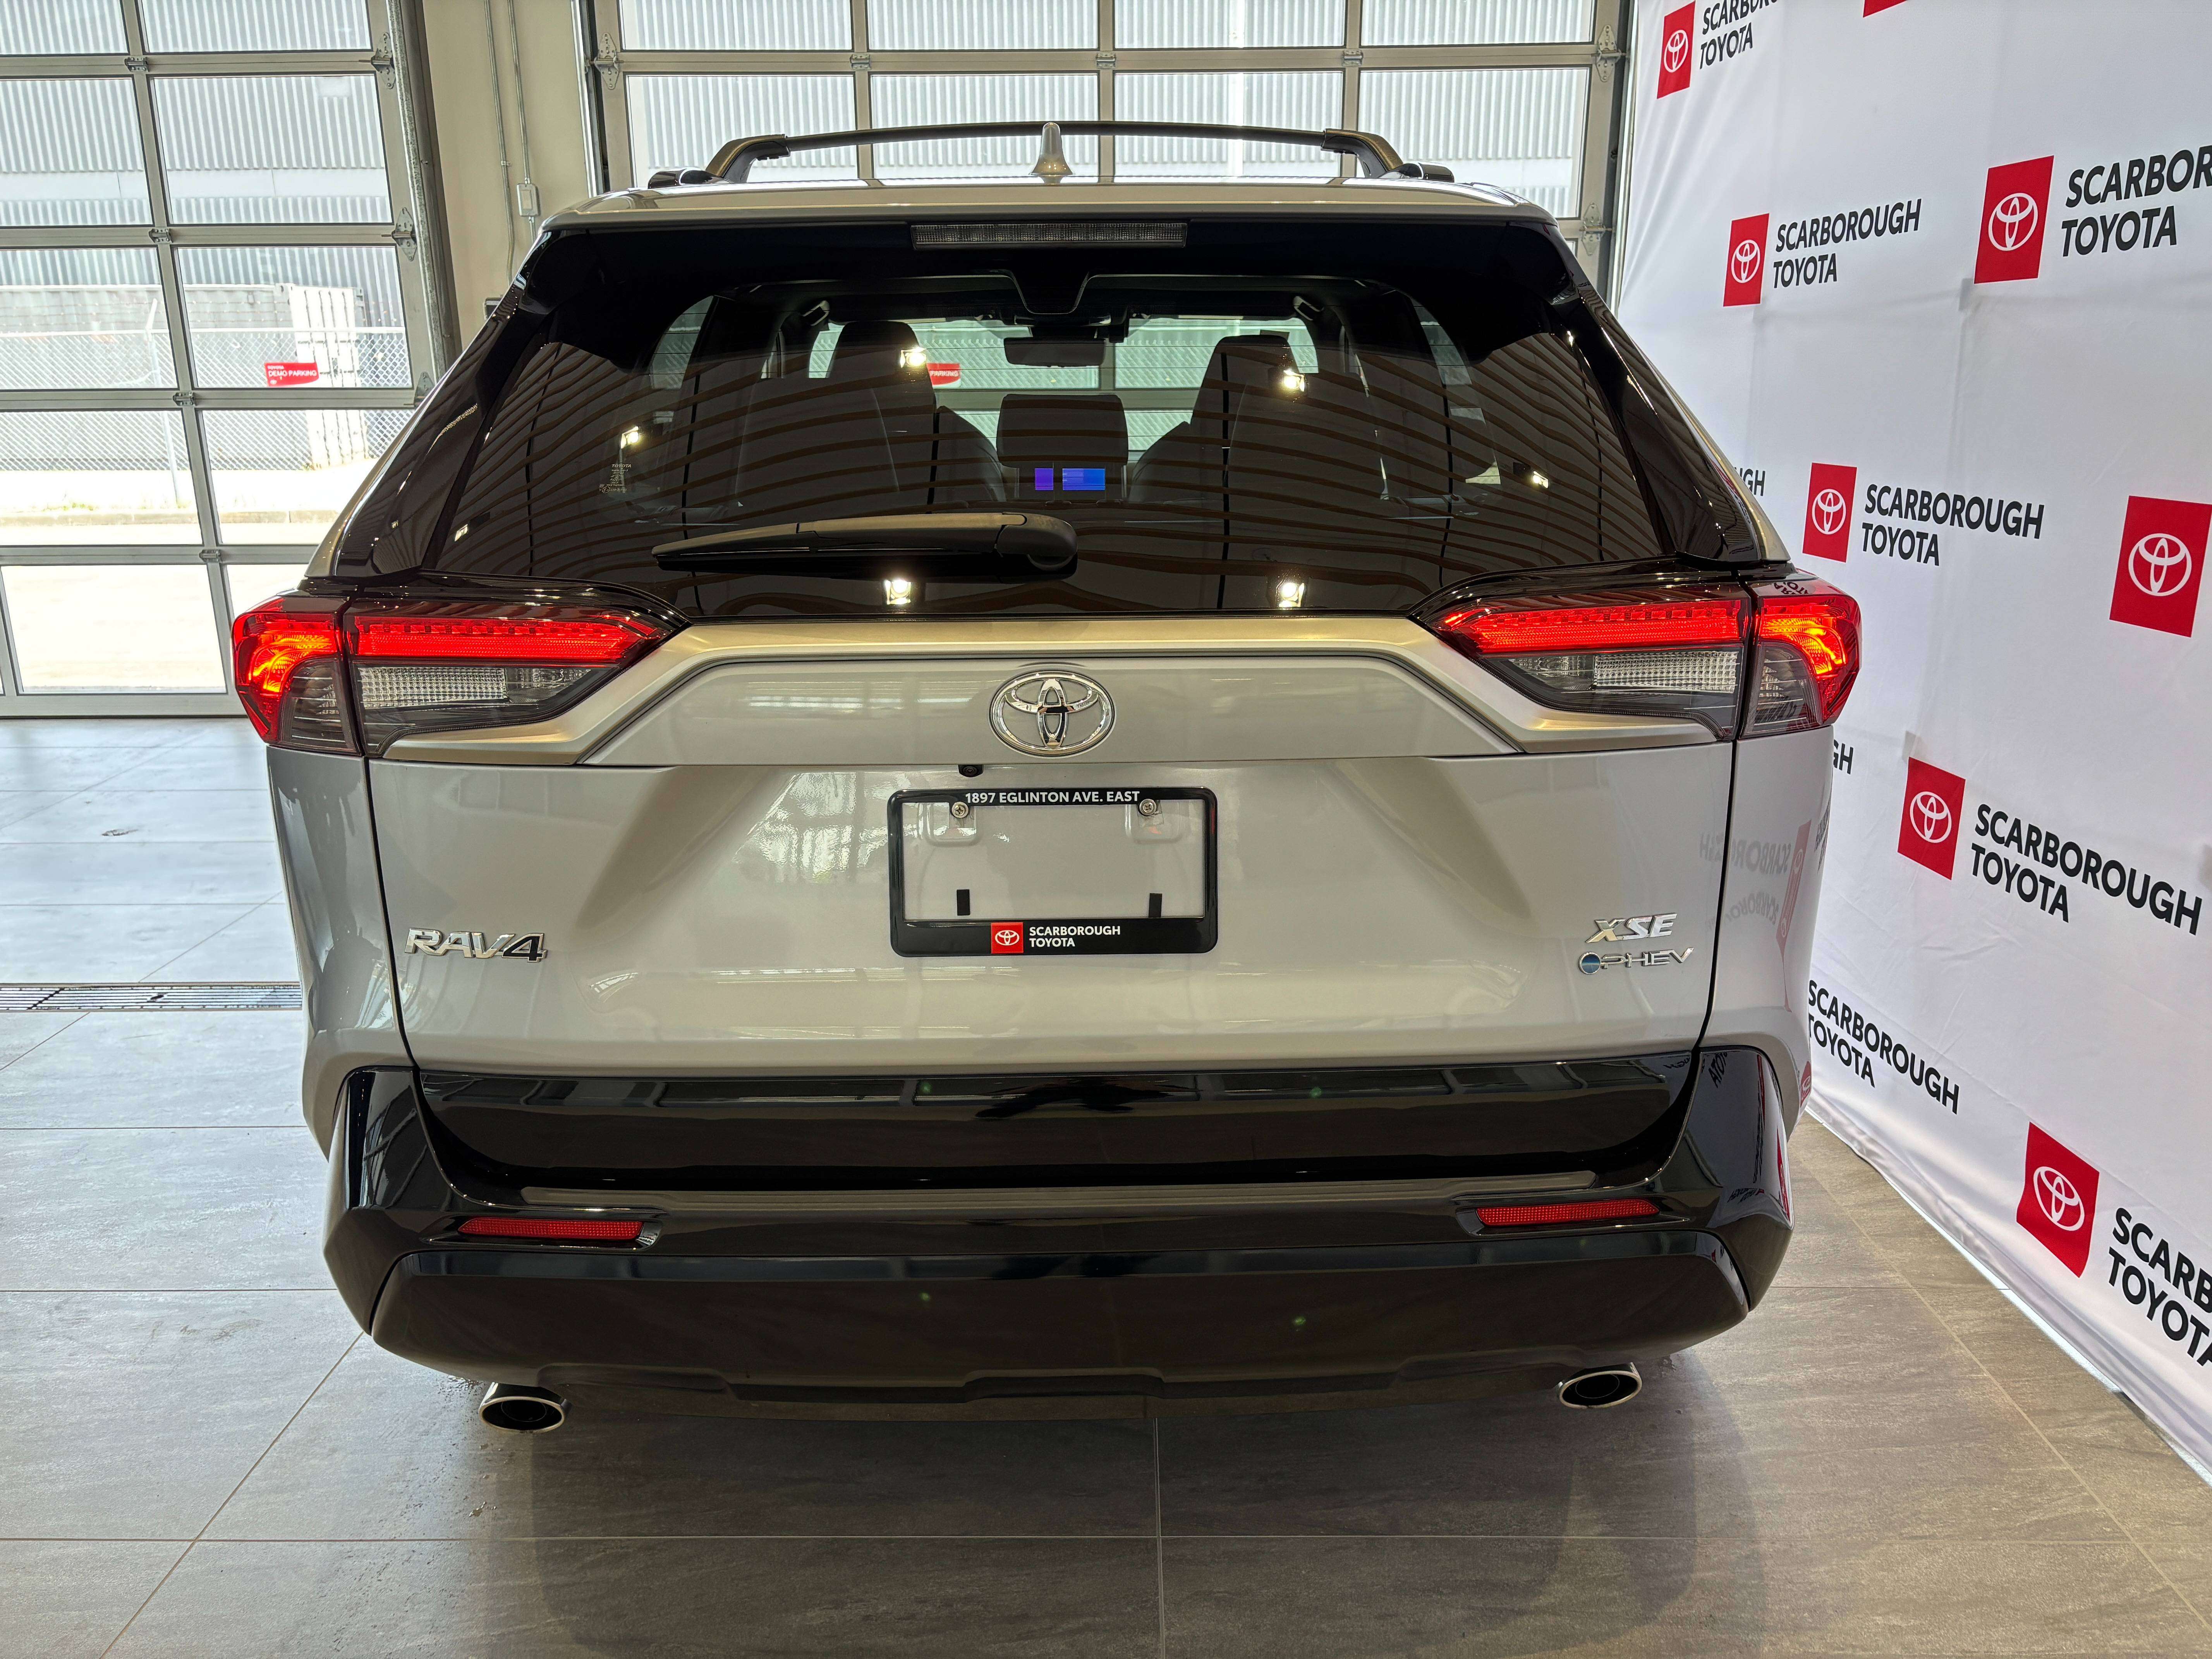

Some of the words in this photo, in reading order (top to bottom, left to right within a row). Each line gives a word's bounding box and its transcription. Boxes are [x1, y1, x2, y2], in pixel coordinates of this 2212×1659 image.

[1702, 0, 1777, 35] SCARB
[1700, 22, 1753, 69] TOYOTA
[2066, 145, 2212, 208] SCARBOR
[1776, 198, 1922, 252] SCARBOROUGH
[2062, 206, 2177, 257] TOYOTA
[1773, 253, 1837, 289] TOYOTA
[1865, 484, 2044, 539] SCARBOROUGH
[1862, 522, 1939, 566] TOYOTA
[965, 792, 996, 803] 1897
[999, 792, 1069, 803] EGLINTON
[1072, 791, 1103, 802] AVE.
[1106, 791, 1140, 802] EAST
[1972, 842, 2069, 923] TOYOTA
[1975, 804, 2202, 936] SCARBOROUGH
[405, 928, 548, 963] RAV4
[1029, 926, 1120, 936] SCARBOROUGH
[1029, 938, 1075, 947] TOYOTA
[1585, 912, 1678, 943] XSE
[1808, 980, 1959, 1115] SCARBOROUGH
[1809, 1012, 1875, 1088] TOYOTA
